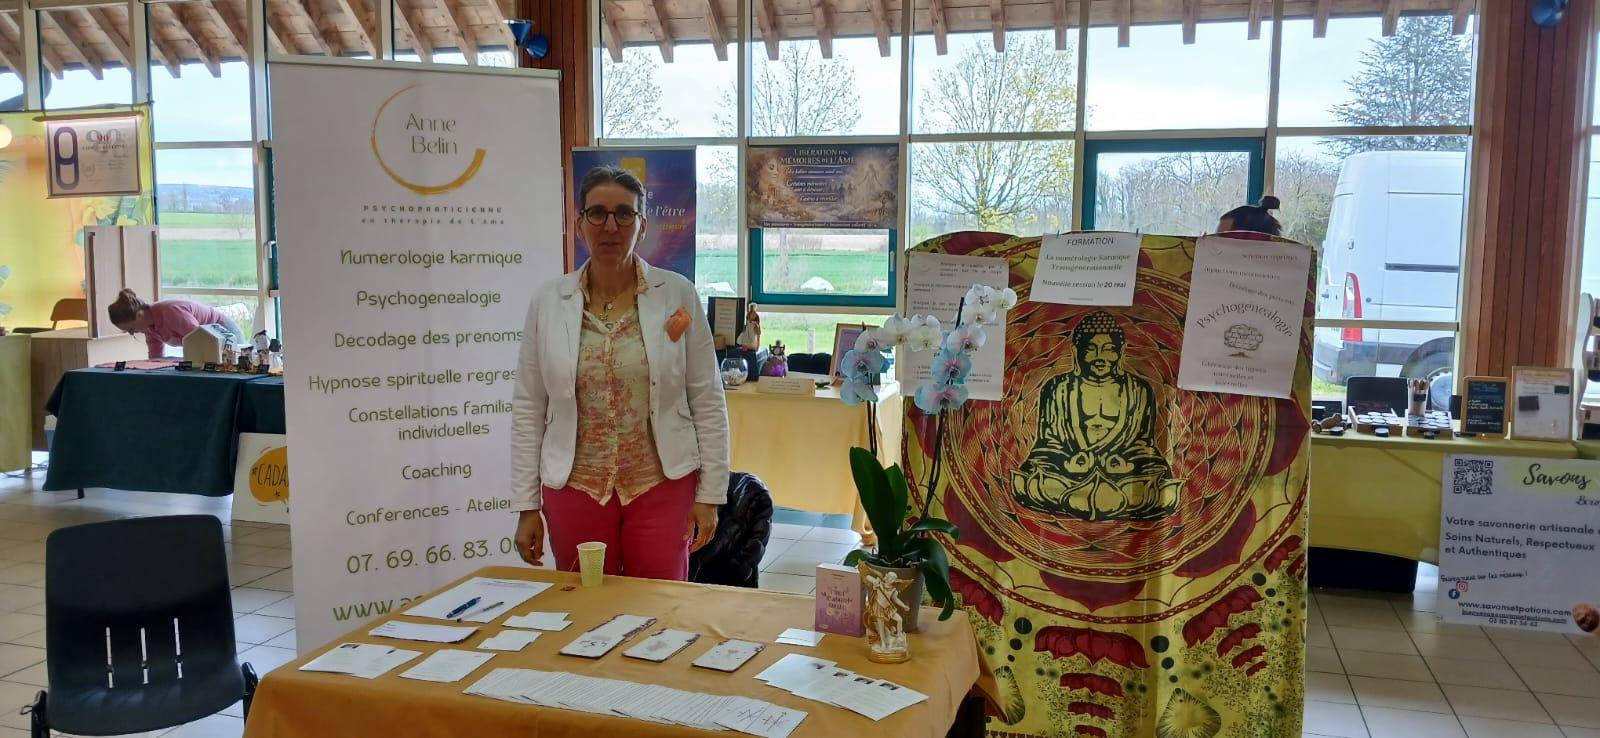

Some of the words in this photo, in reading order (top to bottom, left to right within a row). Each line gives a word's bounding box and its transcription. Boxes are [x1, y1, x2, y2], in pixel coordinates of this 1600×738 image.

[405, 112, 457, 132] Anne
[411, 135, 458, 154] Belin
[655, 205, 686, 217] l'être
[1066, 236, 1114, 247] FORMATION
[340, 249, 446, 269] Numerologie
[450, 249, 523, 268] karmique
[356, 290, 502, 310] Psychogenealogie
[334, 331, 417, 350] Decodage
[422, 330, 450, 345] des
[455, 329, 525, 348] prenoms
[308, 374, 381, 394] Hypnose
[386, 369, 462, 390] spirituelle
[467, 369, 518, 386] regres
[348, 403, 458, 423] Constellations
[464, 400, 514, 416] familia
[398, 421, 490, 441] individuelles
[257, 463, 289, 488] CADA
[402, 463, 472, 480] Coaching
[1523, 463, 1592, 490] Savons
[346, 503, 449, 526] Conferences
[1446, 516, 1475, 527] Votre
[1478, 520, 1535, 531] savonnerie
[1539, 523, 1594, 535] artisanale
[1445, 532, 1472, 542] Soins
[1475, 534, 1523, 547] Naturels,
[1526, 537, 1596, 551] Respectueux
[346, 553, 379, 574] 07.
[386, 549, 419, 569] 69.
[425, 545, 456, 565] 66.
[463, 540, 494, 560] 83.
[499, 536, 519, 554] 0
[1445, 546, 1455, 554] et
[1458, 546, 1527, 560] Authentiques
